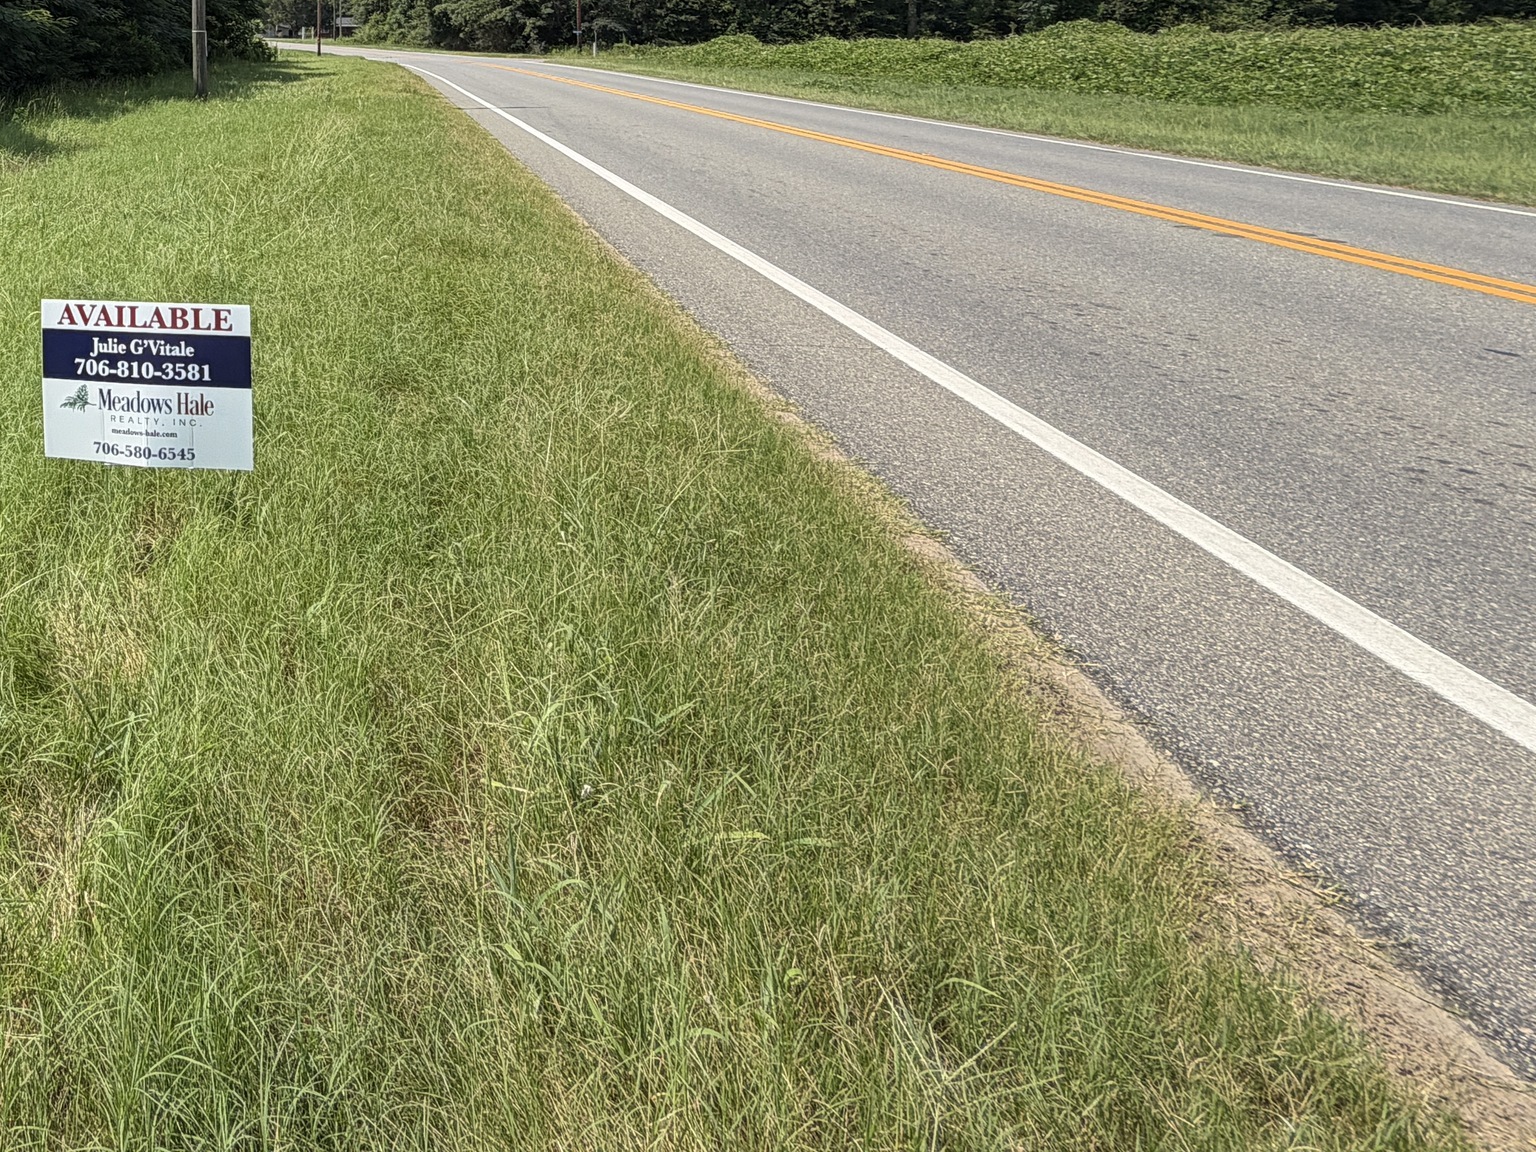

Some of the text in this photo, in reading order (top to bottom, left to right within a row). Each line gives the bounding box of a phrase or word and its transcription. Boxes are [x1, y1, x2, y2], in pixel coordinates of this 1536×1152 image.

[57, 303, 233, 332] AVAILABLE
[90, 337, 127, 357] Julie
[74, 358, 212, 381] 706-810-3581
[98, 388, 215, 416] Meadows Hale
[172, 418, 203, 427] INC.
[111, 427, 178, 439] meadows-hale.com
[93, 441, 196, 461] 706-580-6545
